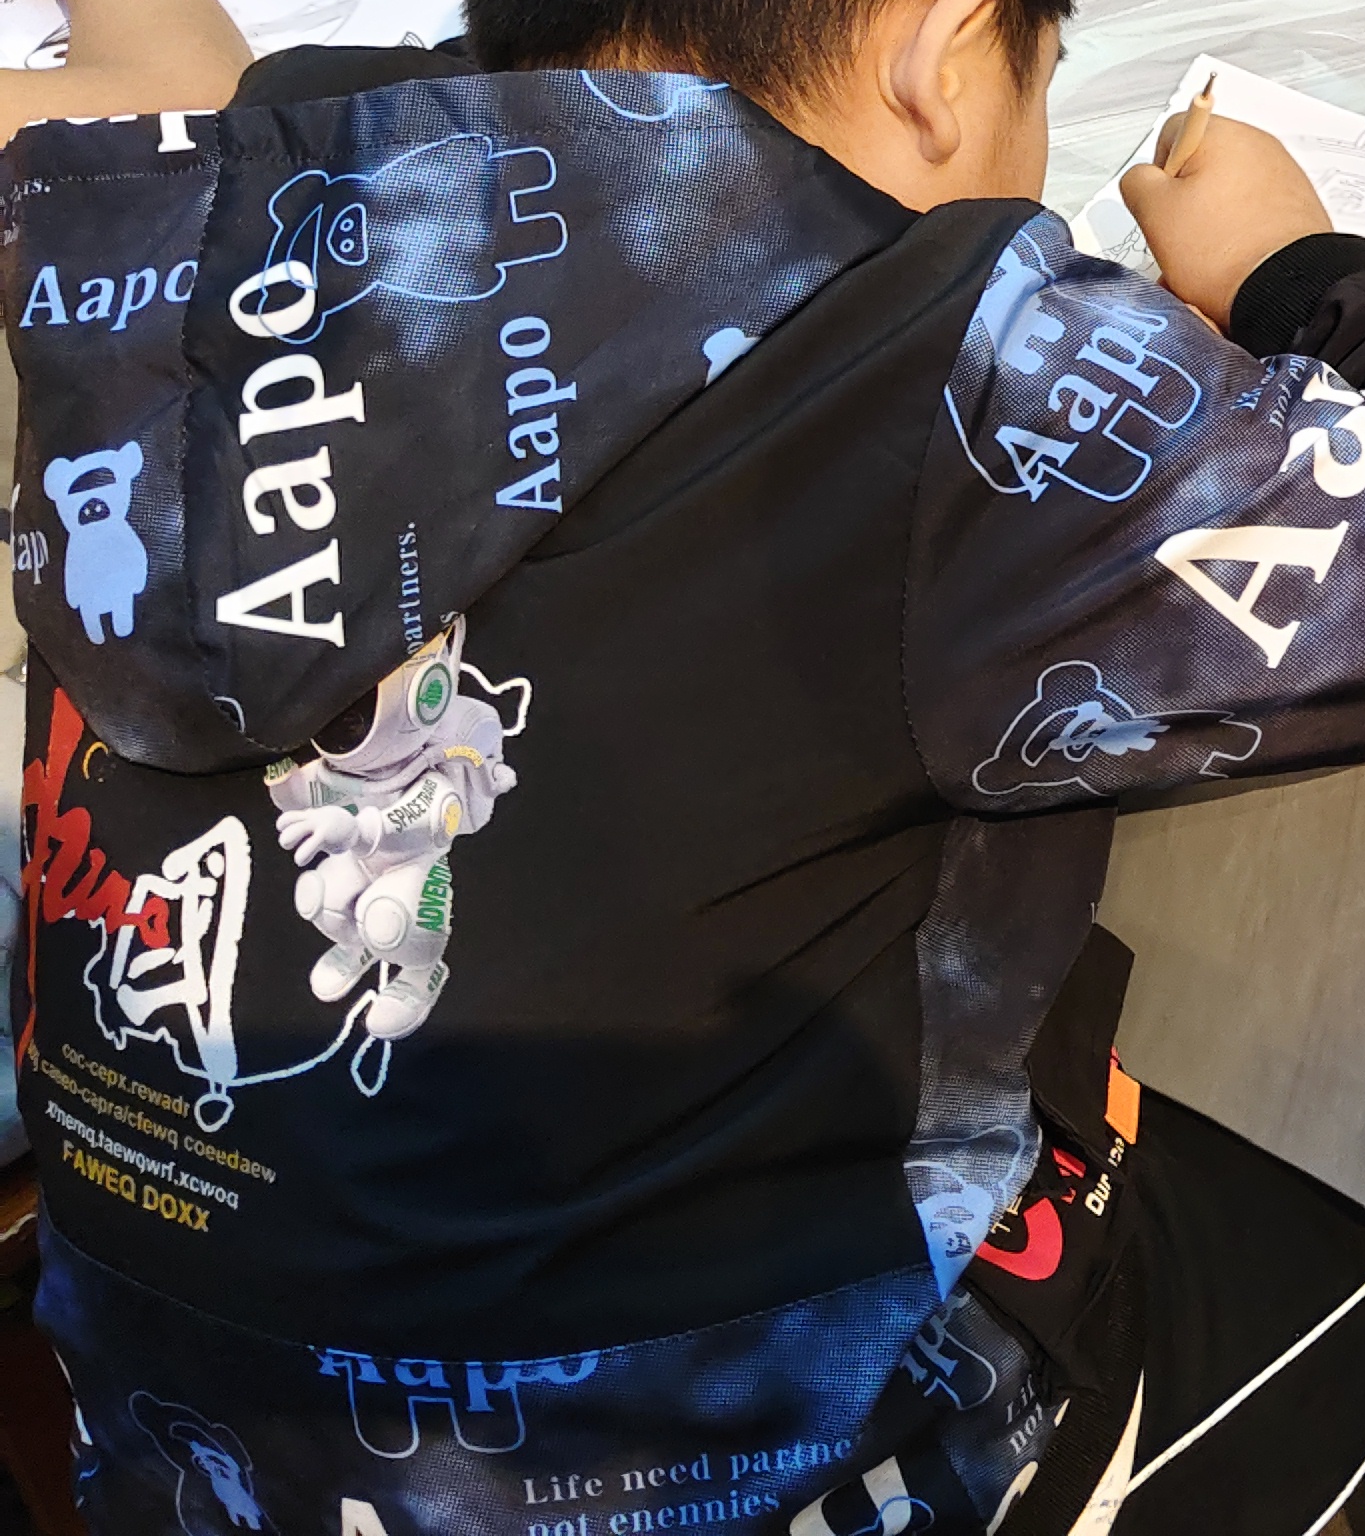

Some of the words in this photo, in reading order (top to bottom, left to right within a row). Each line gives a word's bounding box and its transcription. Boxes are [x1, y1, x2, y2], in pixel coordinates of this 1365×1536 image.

[215, 259, 367, 649] Aapo
[495, 315, 577, 514] Aapo
[142, 1184, 211, 1233] DOXX
[524, 1474, 603, 1506] Life
[620, 1453, 713, 1493] need
